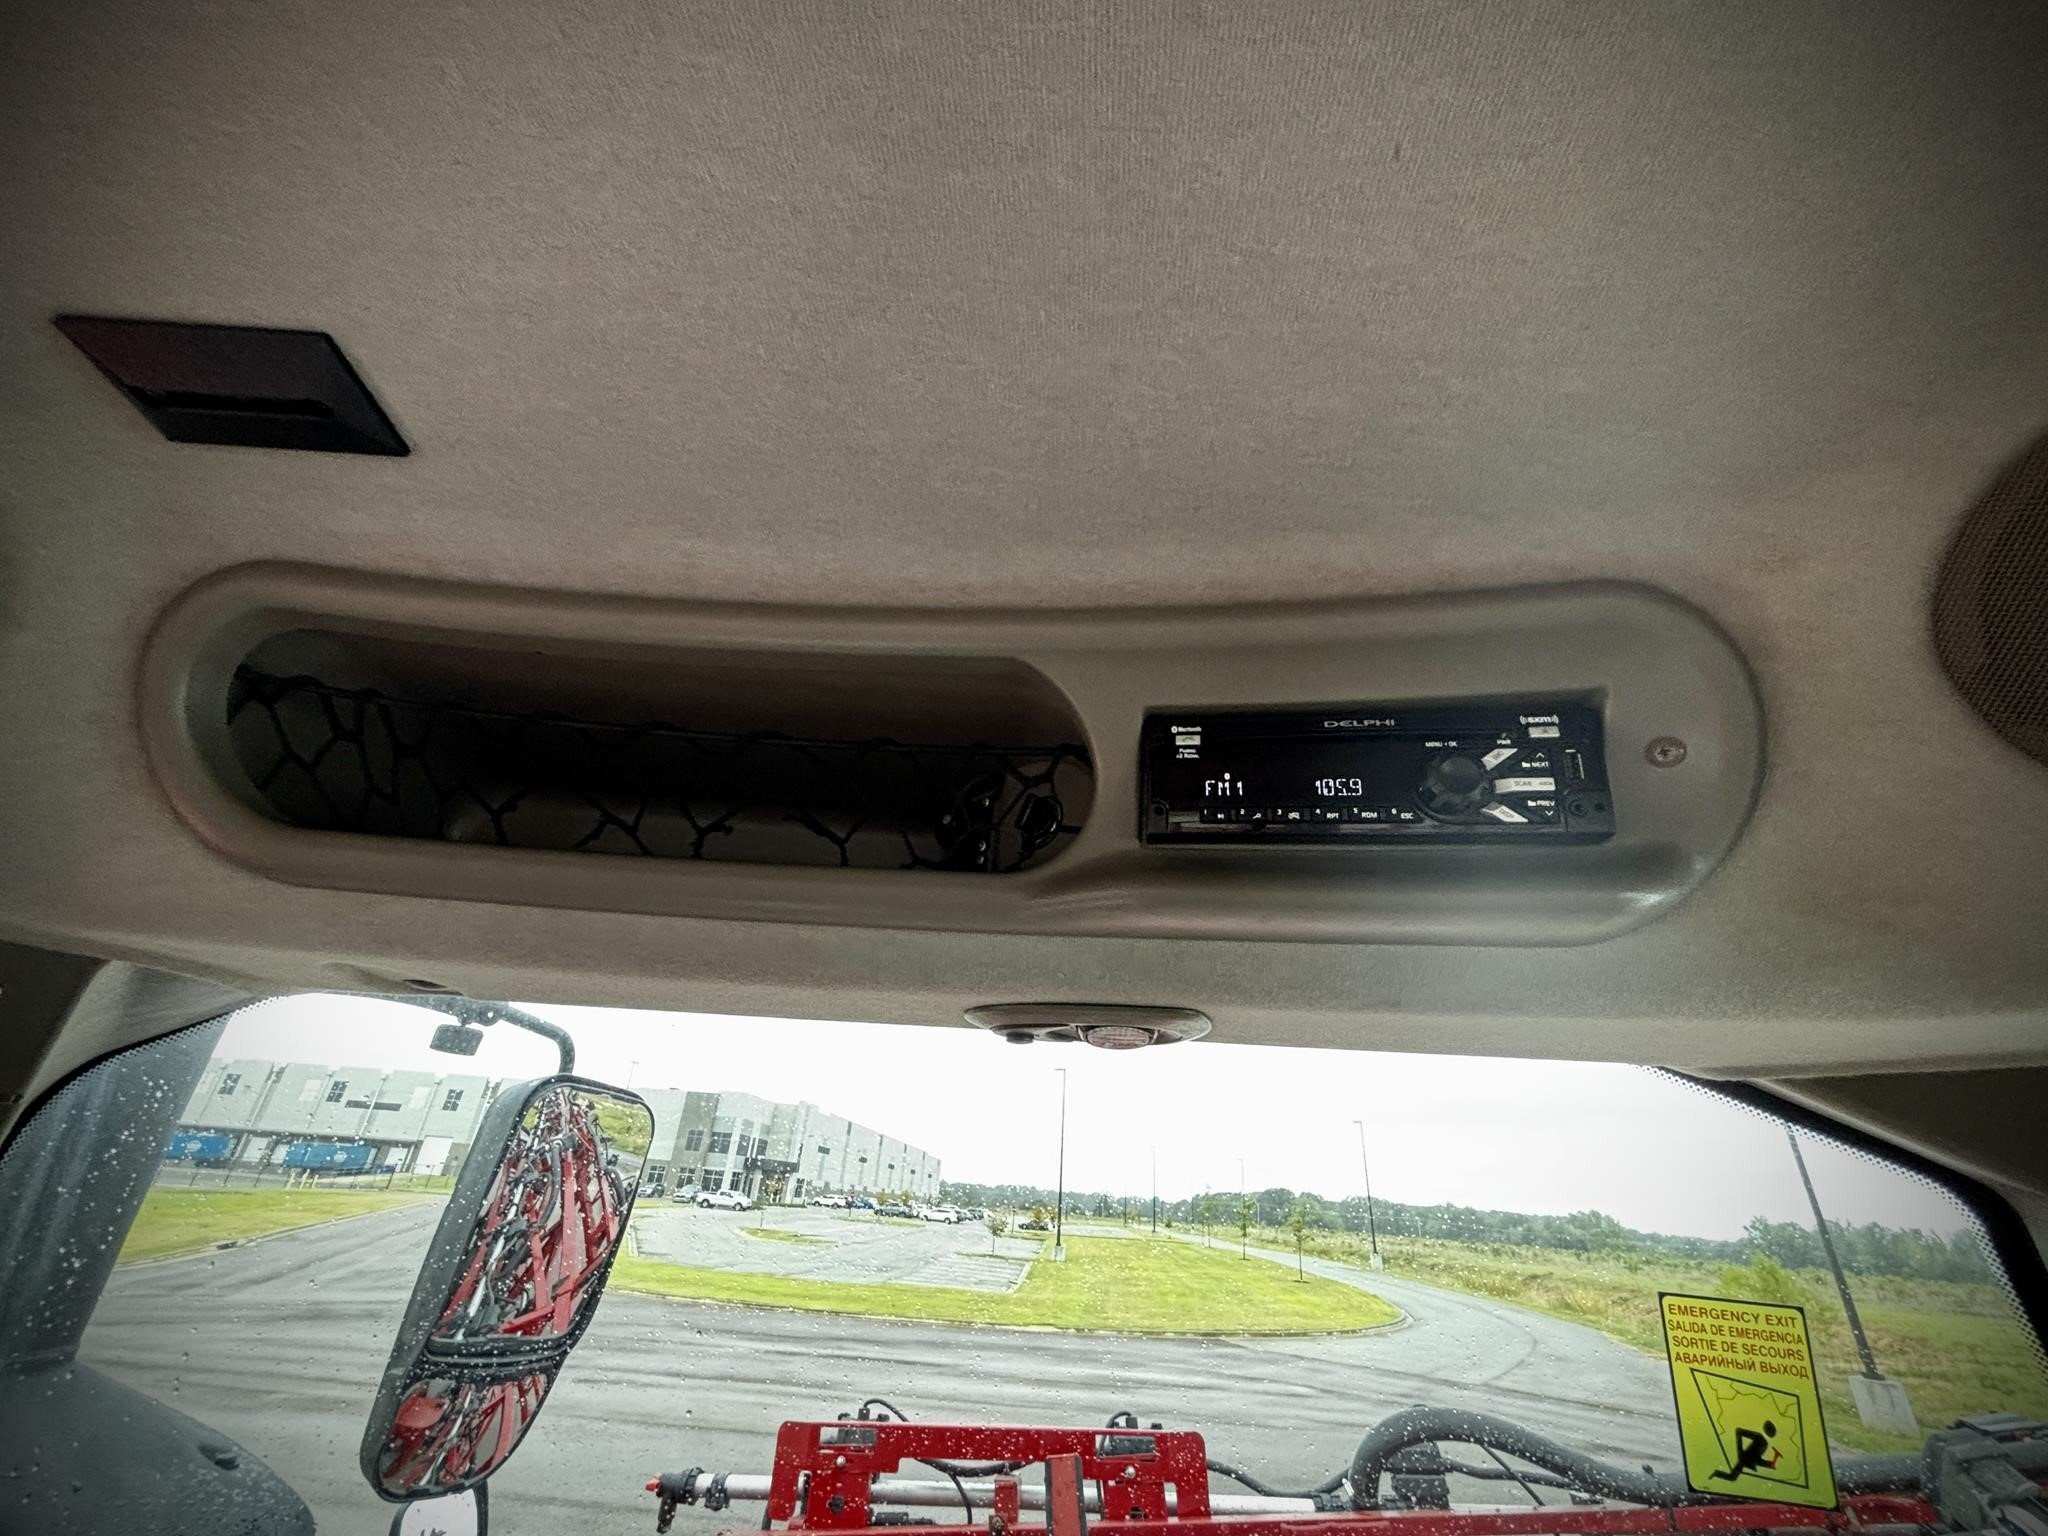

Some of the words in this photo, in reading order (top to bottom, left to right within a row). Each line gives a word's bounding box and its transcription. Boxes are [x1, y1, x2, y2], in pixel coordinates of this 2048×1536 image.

[1323, 719, 1395, 728] DELPHI
[1361, 811, 1378, 819] RDM
[1668, 1304, 1760, 1324] EMERGENCY
[1765, 1314, 1798, 1329] EXIT
[1667, 1319, 1708, 1335] SALIDA
[1710, 1324, 1726, 1337] DE
[1728, 1326, 1805, 1346] EMERGENCIA
[1672, 1335, 1719, 1352] SORTIE
[1721, 1341, 1739, 1354] DE
[1742, 1344, 1805, 1362] SECOURS
[1675, 1352, 1757, 1373] АВАРИЙНЫЙ
[1760, 1361, 1810, 1380] ВЫХОД
